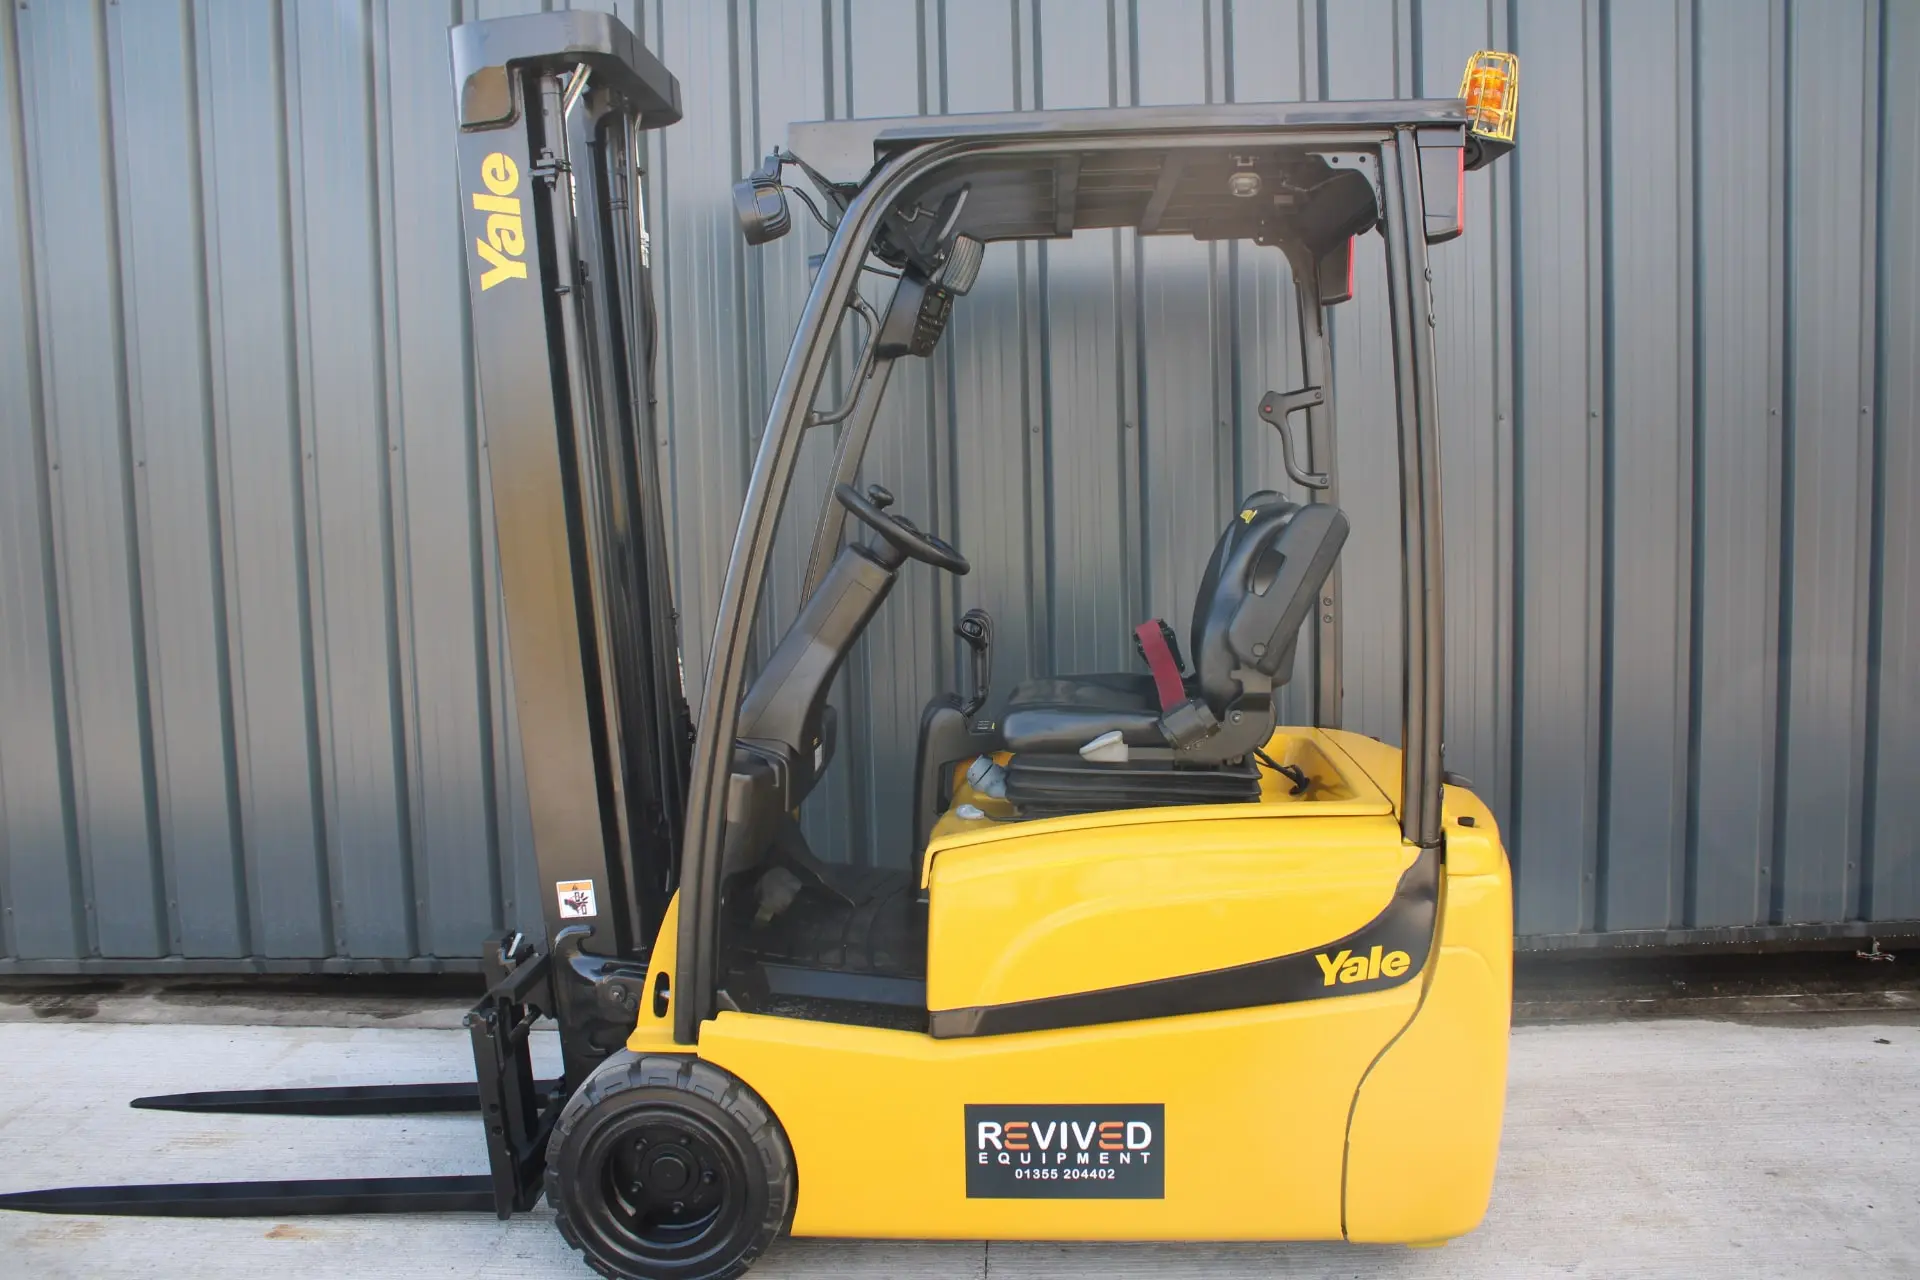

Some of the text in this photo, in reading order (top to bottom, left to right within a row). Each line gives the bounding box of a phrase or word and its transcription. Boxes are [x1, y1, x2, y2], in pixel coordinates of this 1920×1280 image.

[472, 152, 528, 291] Yale
[1315, 944, 1411, 986] Yale
[977, 1121, 1152, 1150] REVIVED
[978, 1151, 1151, 1165] EQUIPMENT
[1014, 1168, 1115, 1180] 01355 204402
